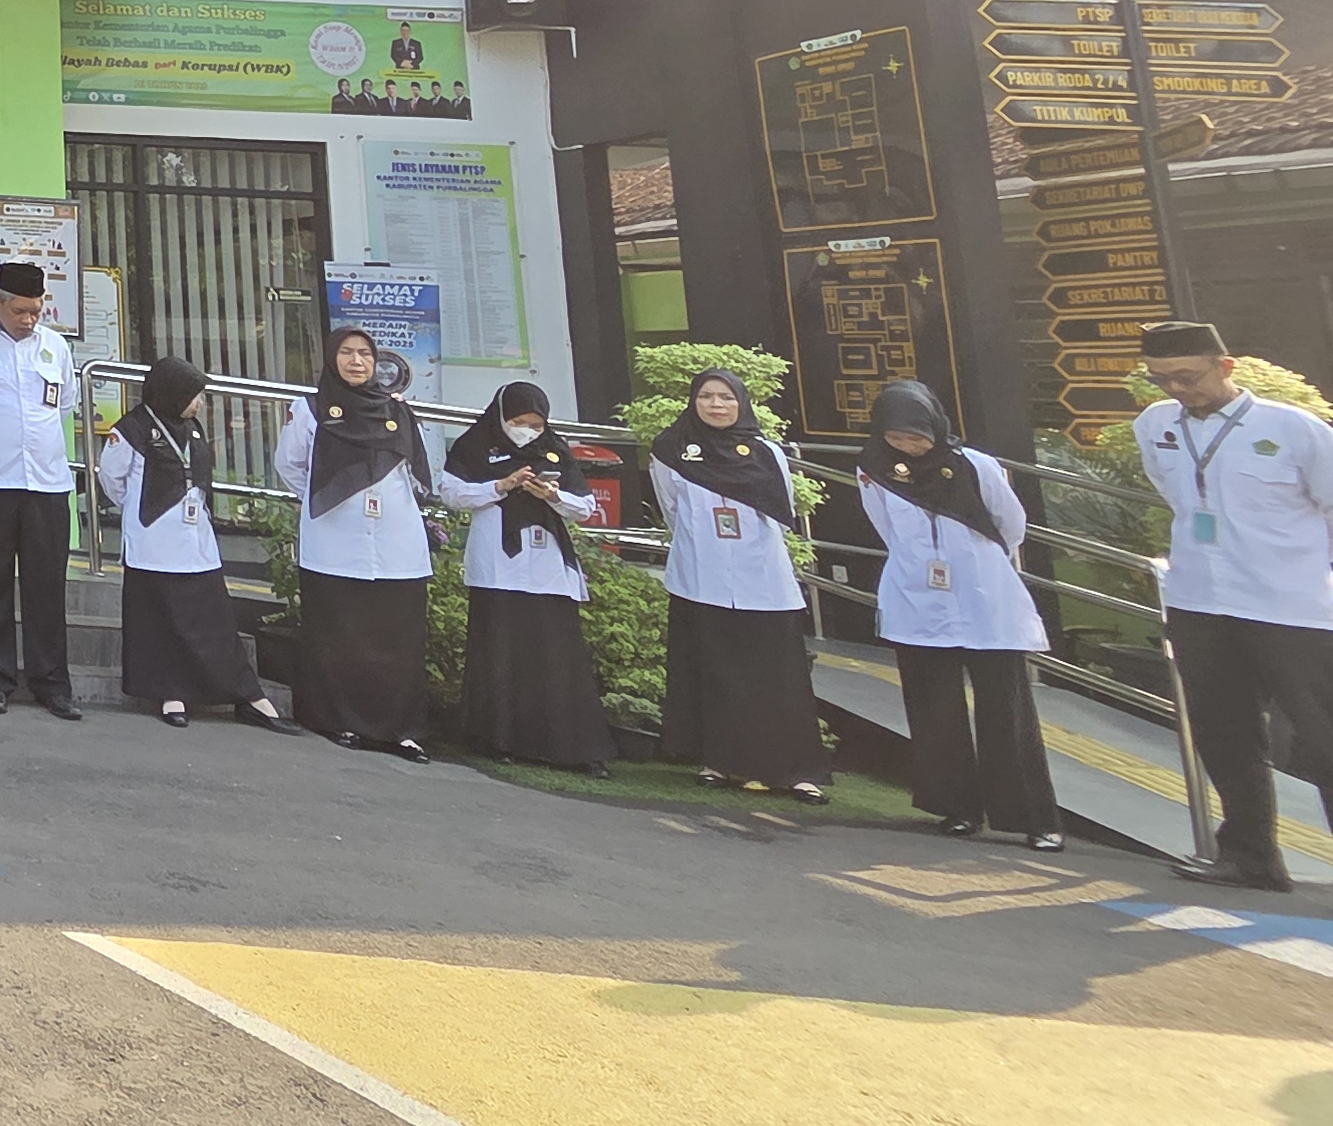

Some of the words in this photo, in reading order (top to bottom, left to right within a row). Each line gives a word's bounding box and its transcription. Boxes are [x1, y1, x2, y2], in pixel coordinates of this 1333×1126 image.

[74, 1, 151, 17] Selamat
[156, 3, 193, 18] dan
[197, 4, 266, 21] Sukses
[1077, 8, 1113, 21] PTSP
[61, 20, 91, 30] antor
[94, 20, 169, 33] Kementerian
[172, 23, 213, 35] Agama
[215, 25, 286, 39] Purbalingga
[76, 36, 111, 48] Telah
[1070, 40, 1121, 56] TOILET
[1148, 42, 1196, 56] TOILET
[105, 57, 149, 69] Bebas
[180, 60, 240, 74] Korupsi
[243, 62, 291, 76] (WBK)
[1007, 71, 1054, 86] PARKIR
[1057, 73, 1093, 87] RODA
[1095, 74, 1105, 88] 2
[1108, 75, 1113, 88] /
[1118, 75, 1127, 89] 4
[1154, 77, 1227, 92] SMOOKING
[1232, 79, 1270, 93] AREA
[1033, 106, 1071, 121] TITIK
[1074, 107, 1132, 123] KUMPUL
[1071, 148, 1140, 169] PERTEMUAN
[391, 162, 417, 173] JENIS
[419, 163, 460, 174] LAYANAN
[462, 164, 486, 176] PTSP
[385, 183, 434, 191] KABUPATEN
[436, 185, 494, 193] PURBALINGGA
[413, 176, 471, 184] KEMENTERIAN
[1044, 185, 1116, 205] SEKRETARIAT
[1050, 222, 1088, 238] RUANG
[1090, 216, 1153, 234] POKJAWAS
[1108, 251, 1158, 267] PANTRY
[342, 283, 423, 297] SELAMAT
[1067, 286, 1150, 304] SEKRETARIAT
[350, 294, 416, 307] SUKSES
[367, 330, 414, 339] EDIKAT
